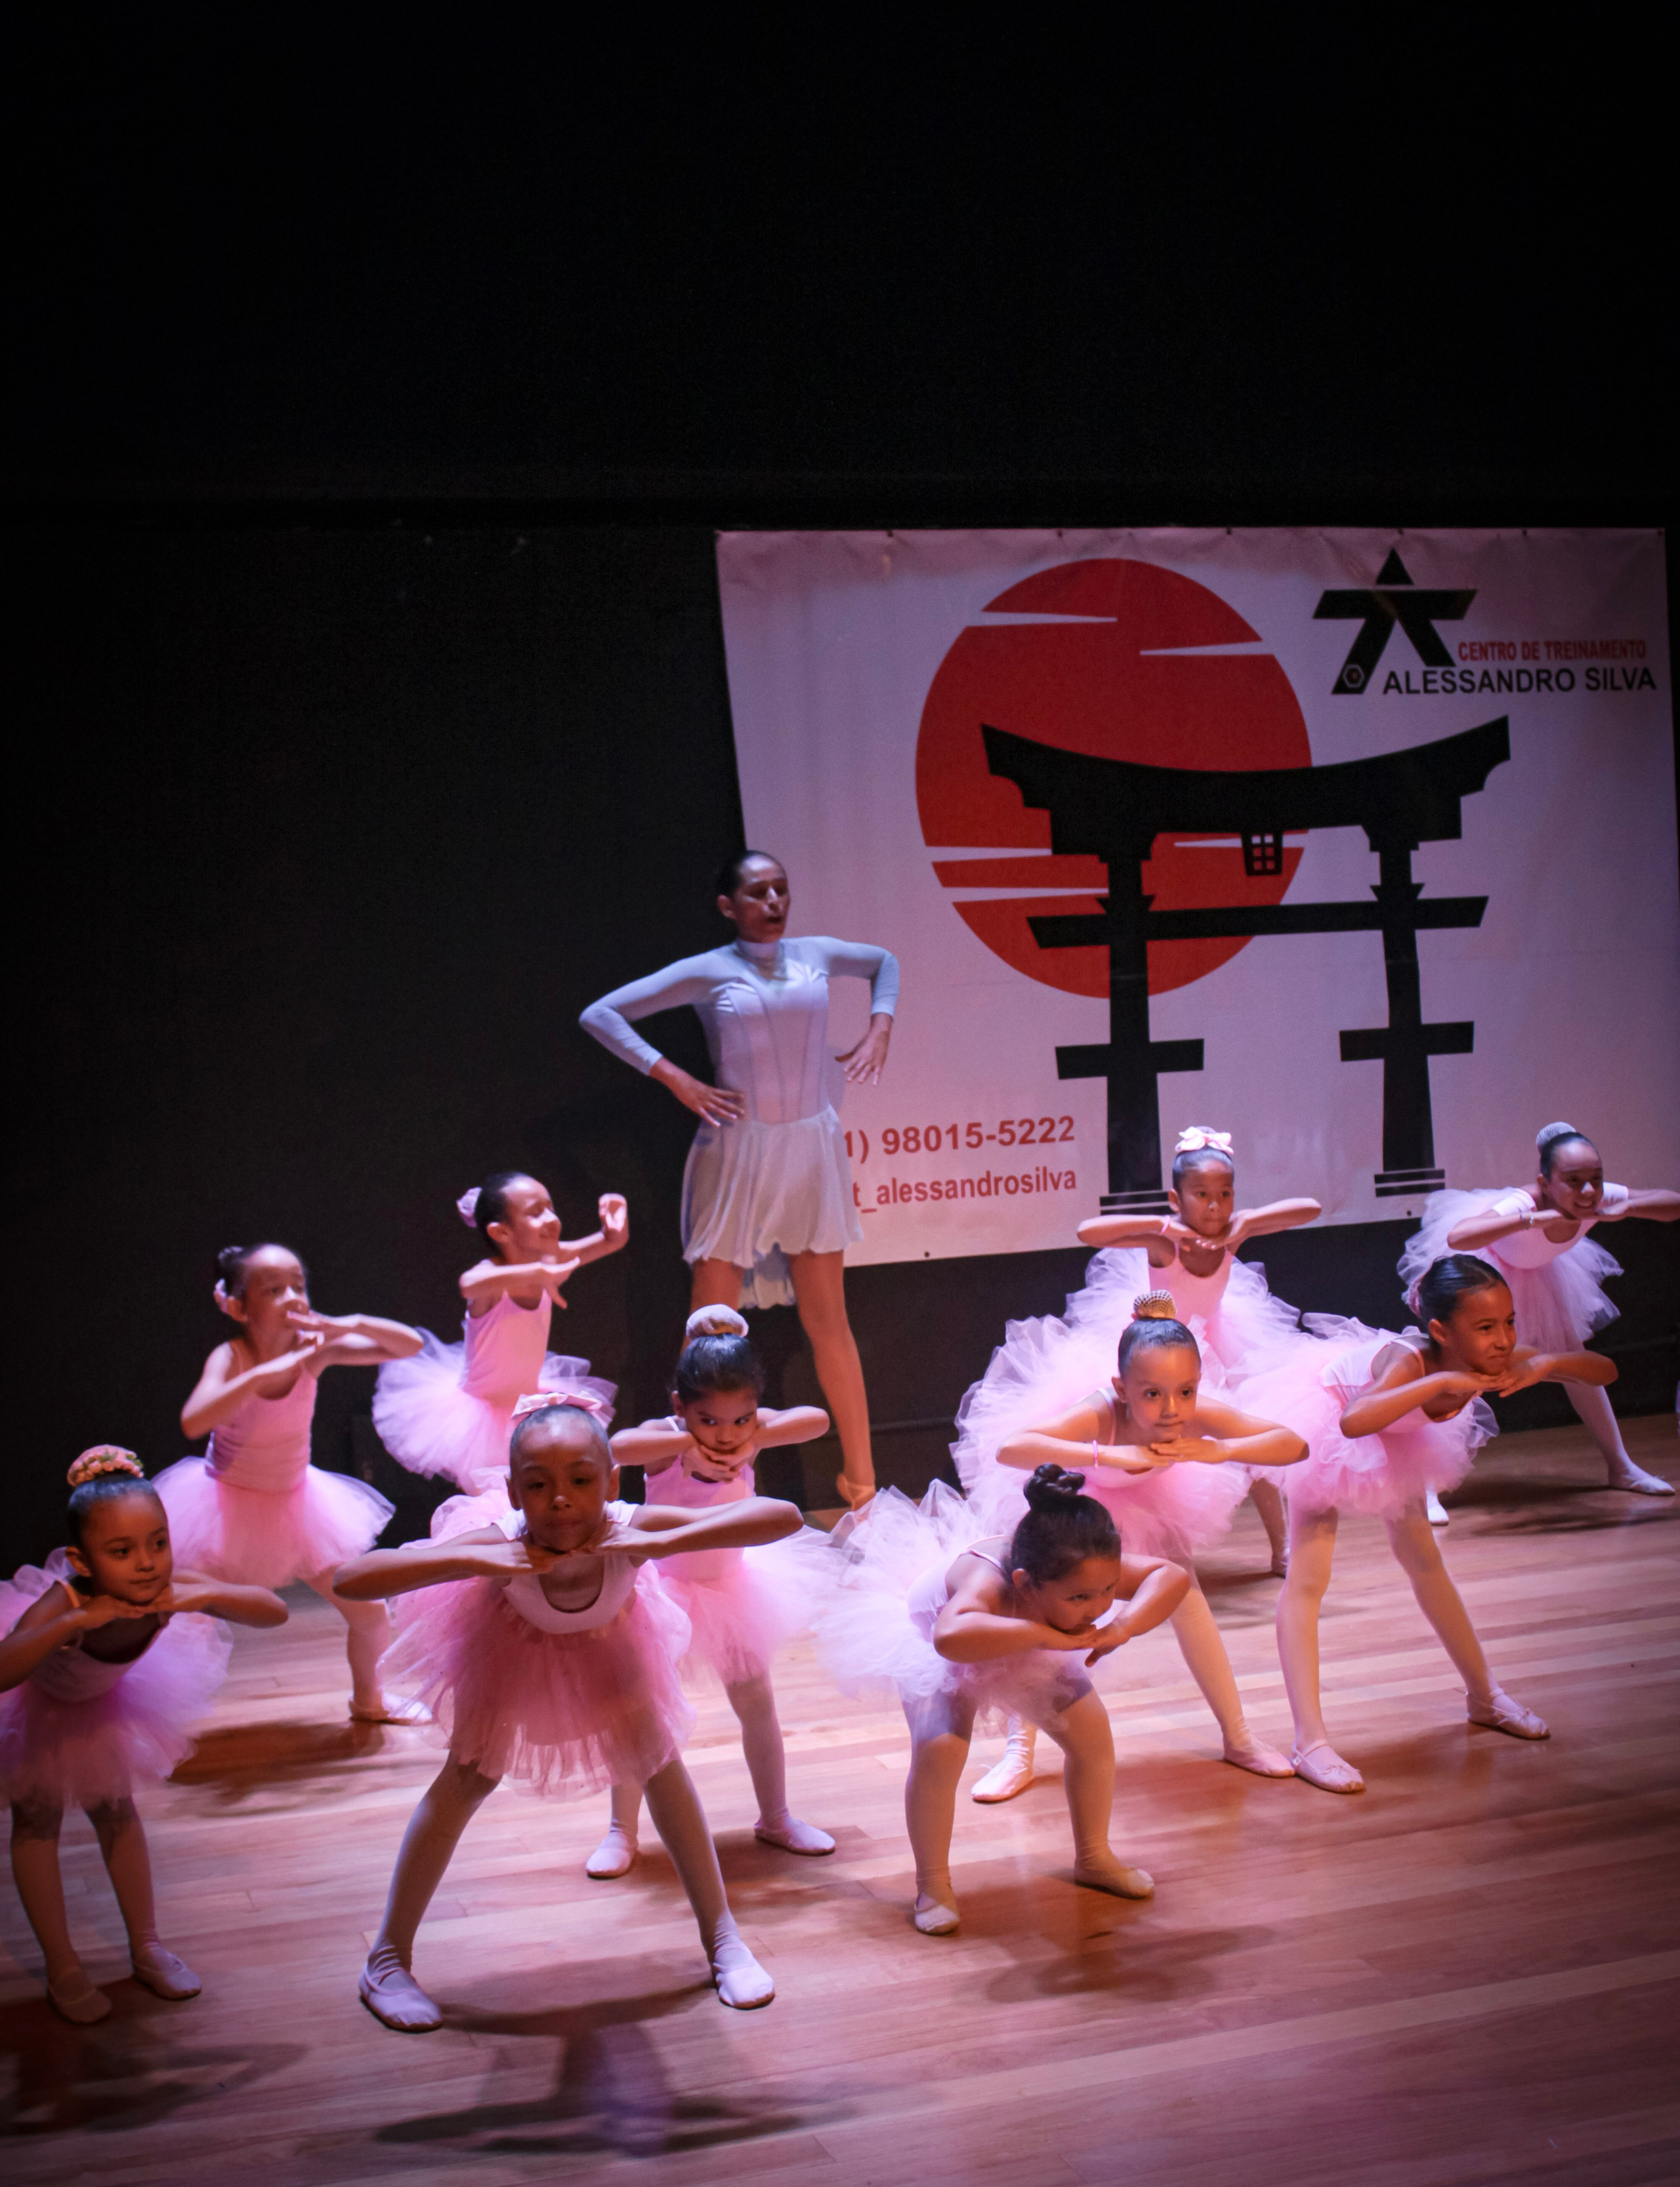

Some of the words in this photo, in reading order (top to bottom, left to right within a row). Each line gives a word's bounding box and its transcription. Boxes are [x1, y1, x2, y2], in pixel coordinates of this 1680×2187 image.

[1459, 641, 1517, 661] CENTRO
[1521, 640, 1540, 660] DE
[1544, 639, 1646, 660] TREINAMENTO
[1383, 669, 1576, 694] ALESSANDRO
[1585, 667, 1656, 691] SILVA
[882, 1115, 1075, 1155] 98015-5222
